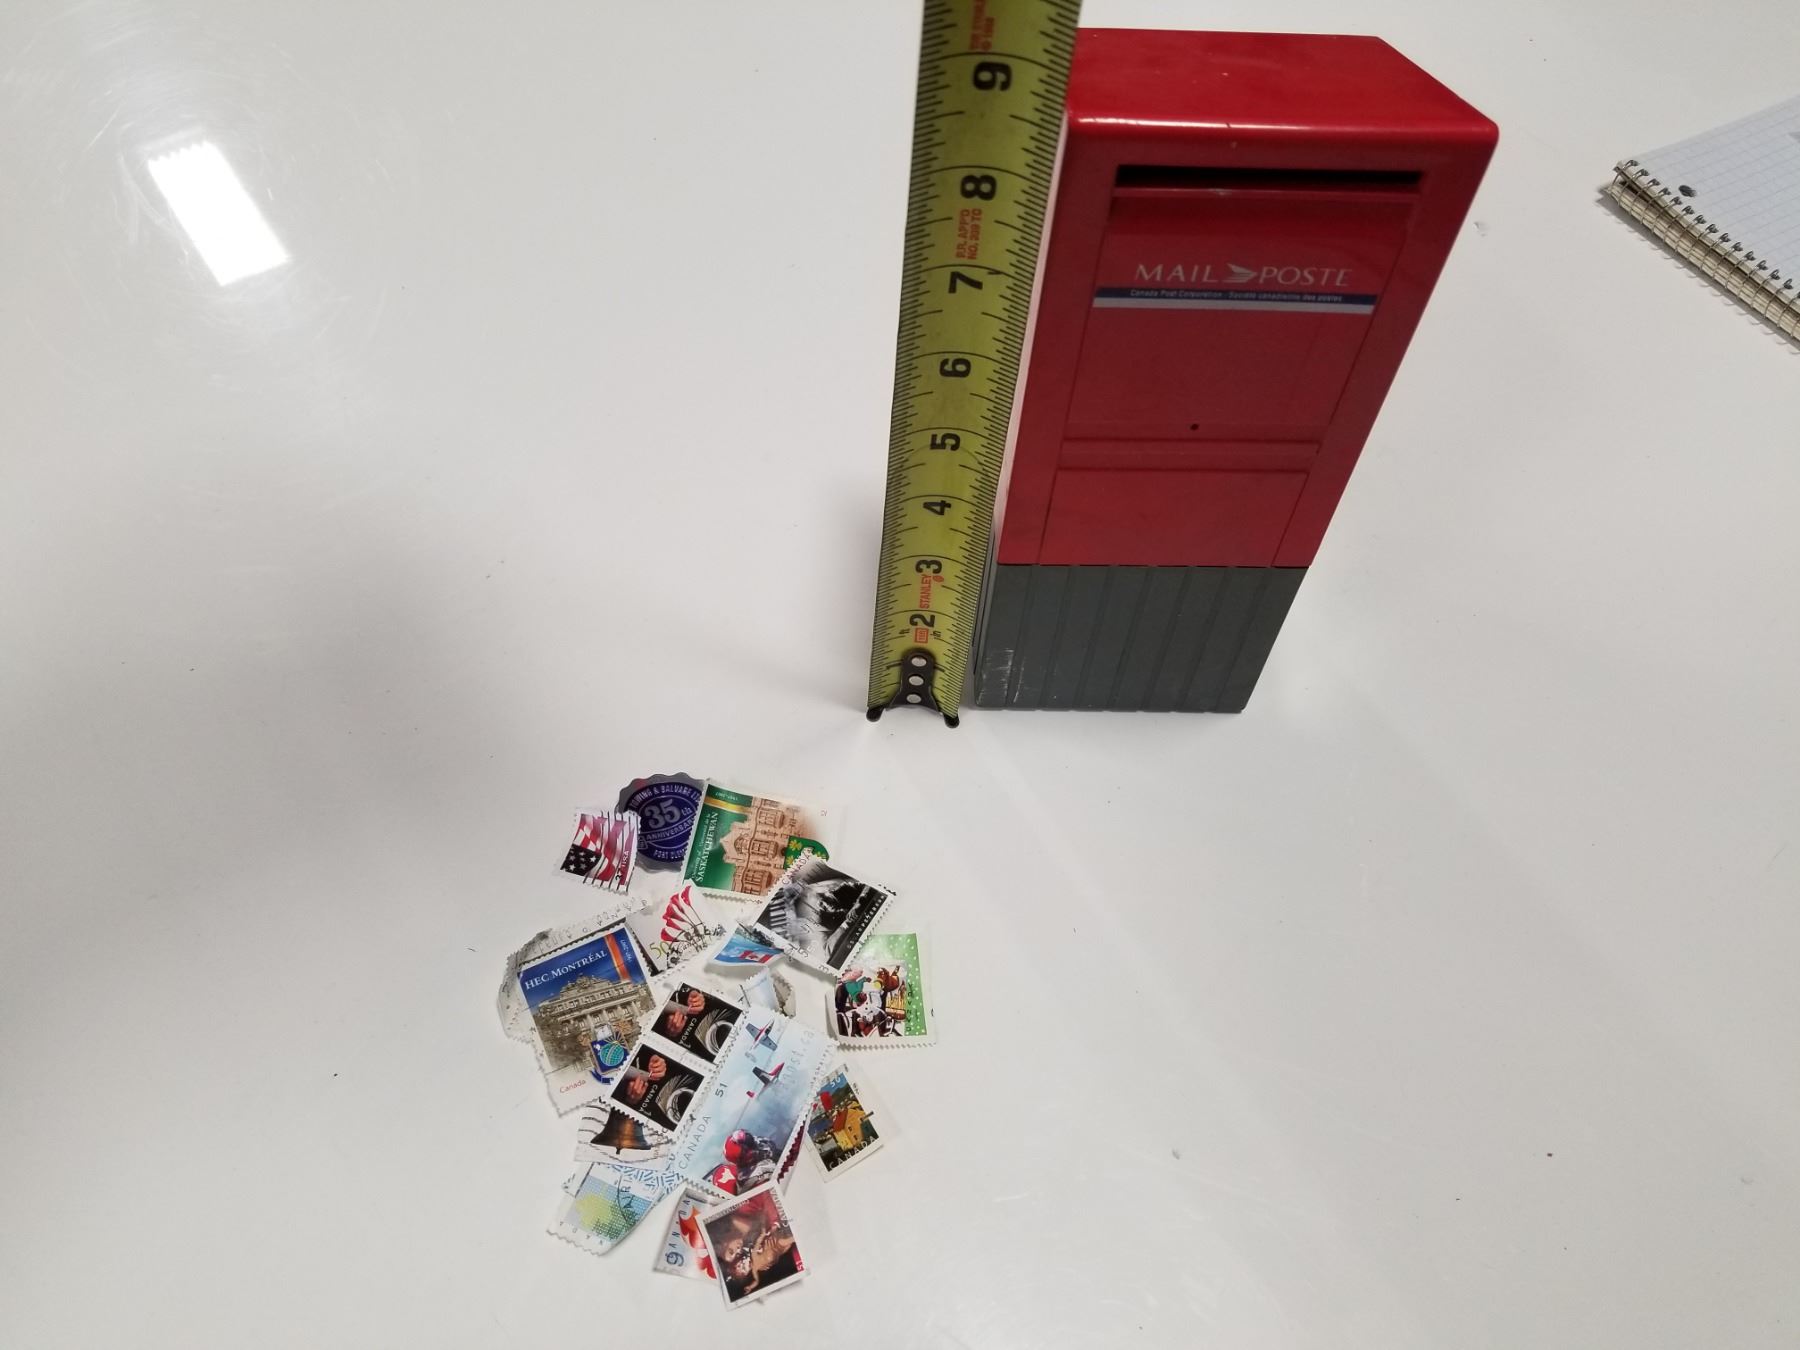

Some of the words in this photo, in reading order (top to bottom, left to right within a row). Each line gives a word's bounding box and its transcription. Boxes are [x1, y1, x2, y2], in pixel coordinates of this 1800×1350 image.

[972, 61, 1012, 92] 9
[960, 174, 997, 201] 8
[948, 270, 983, 294] 7
[1134, 263, 1218, 282] MAIL
[1258, 265, 1352, 287] POSTE
[939, 357, 971, 378] 6
[930, 432, 961, 451] 5
[923, 499, 951, 516] 4
[915, 559, 942, 574] 3
[919, 573, 933, 609] STANLEY
[909, 613, 935, 628] 2
[644, 798, 681, 830] 35
[646, 817, 695, 841] ANNIVERSAR
[695, 811, 719, 882] SASKATCHEWAN
[524, 973, 550, 990] HEC
[550, 950, 608, 979] MONTRÉAL
[678, 1017, 697, 1046] CANADA
[560, 1079, 586, 1094] Canada
[639, 1084, 658, 1113] CANADA
[715, 1083, 728, 1098] 51
[679, 1115, 712, 1170] CANADA
[829, 1135, 878, 1170] CANADA
